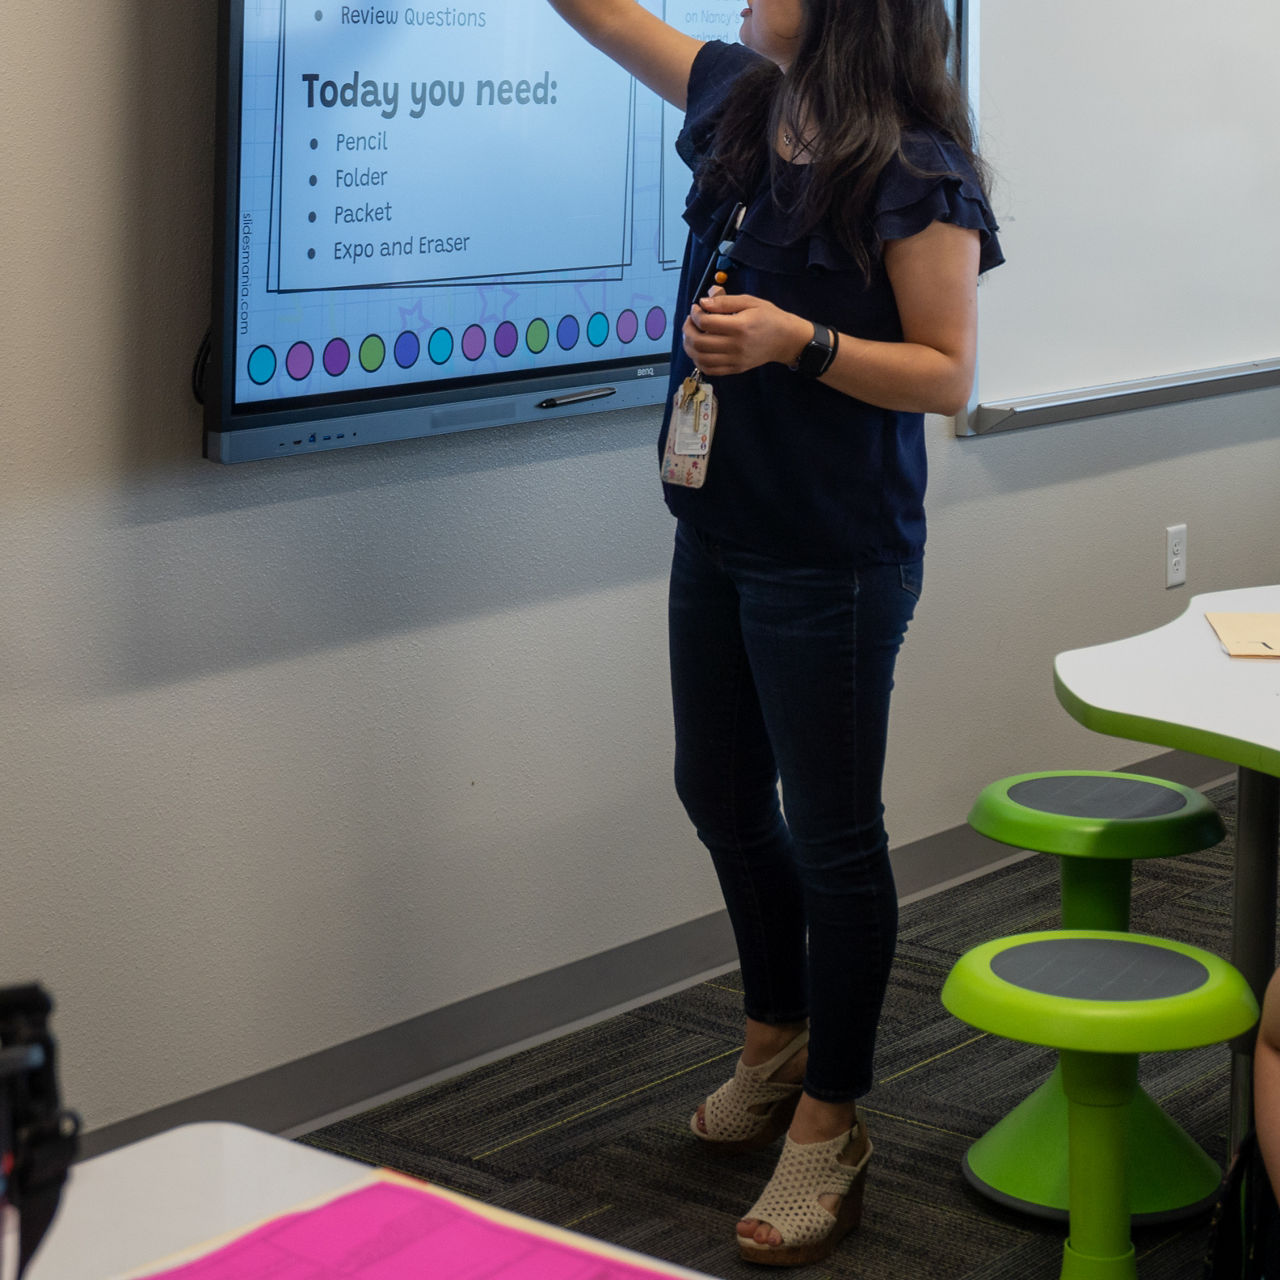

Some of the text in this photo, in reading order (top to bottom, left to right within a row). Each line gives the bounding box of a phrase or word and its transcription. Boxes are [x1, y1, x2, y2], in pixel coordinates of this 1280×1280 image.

[341, 6, 486, 28] Review Questions
[302, 70, 558, 119] Today you need:
[336, 131, 388, 152] Pencil
[336, 168, 387, 188] Folder
[335, 202, 392, 224] Packet
[334, 234, 470, 264] Expo and Eraser
[240, 213, 252, 335] slidesmania.com
